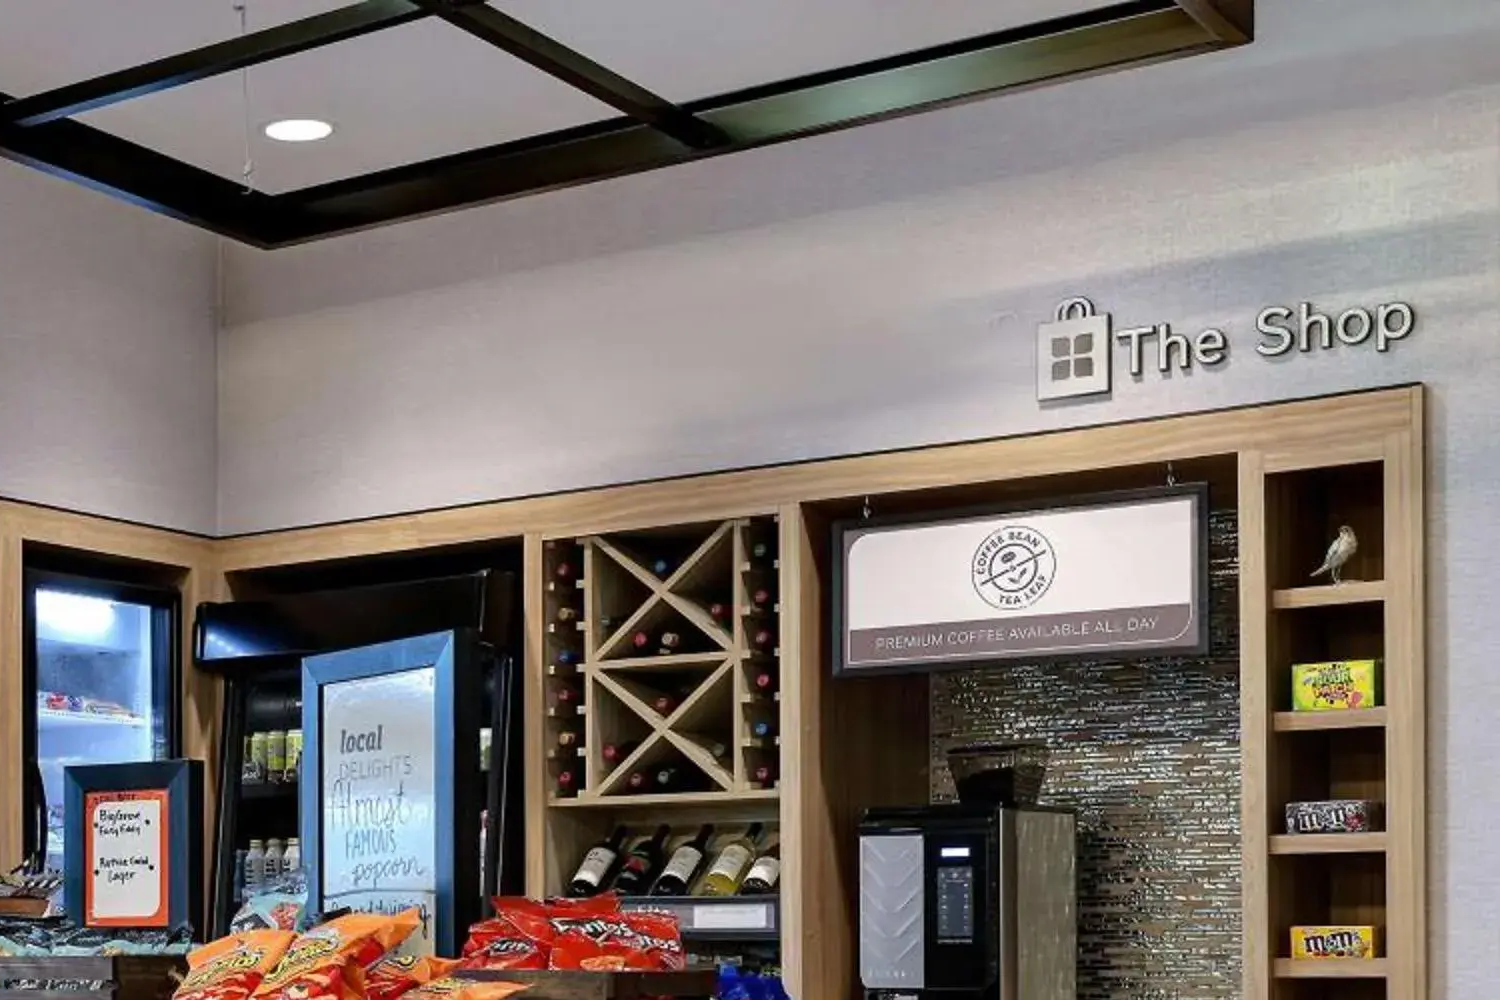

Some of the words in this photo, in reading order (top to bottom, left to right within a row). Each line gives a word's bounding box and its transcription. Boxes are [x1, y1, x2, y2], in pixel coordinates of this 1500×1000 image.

[1116, 322, 1227, 376] The
[1255, 301, 1415, 356] Shop
[975, 535, 1005, 575] COFFEE
[1008, 531, 1041, 548] BEAN
[1000, 594, 1021, 605] TEA
[1024, 574, 1047, 600] LEAF
[875, 633, 943, 650] PREMIUM
[947, 629, 1005, 645] COFFEE
[1008, 623, 1089, 640] AVAILABLE
[1128, 616, 1159, 631] DAY
[338, 725, 383, 754] local
[339, 755, 413, 781] DELIGHTS
[352, 856, 425, 892] popcorn
